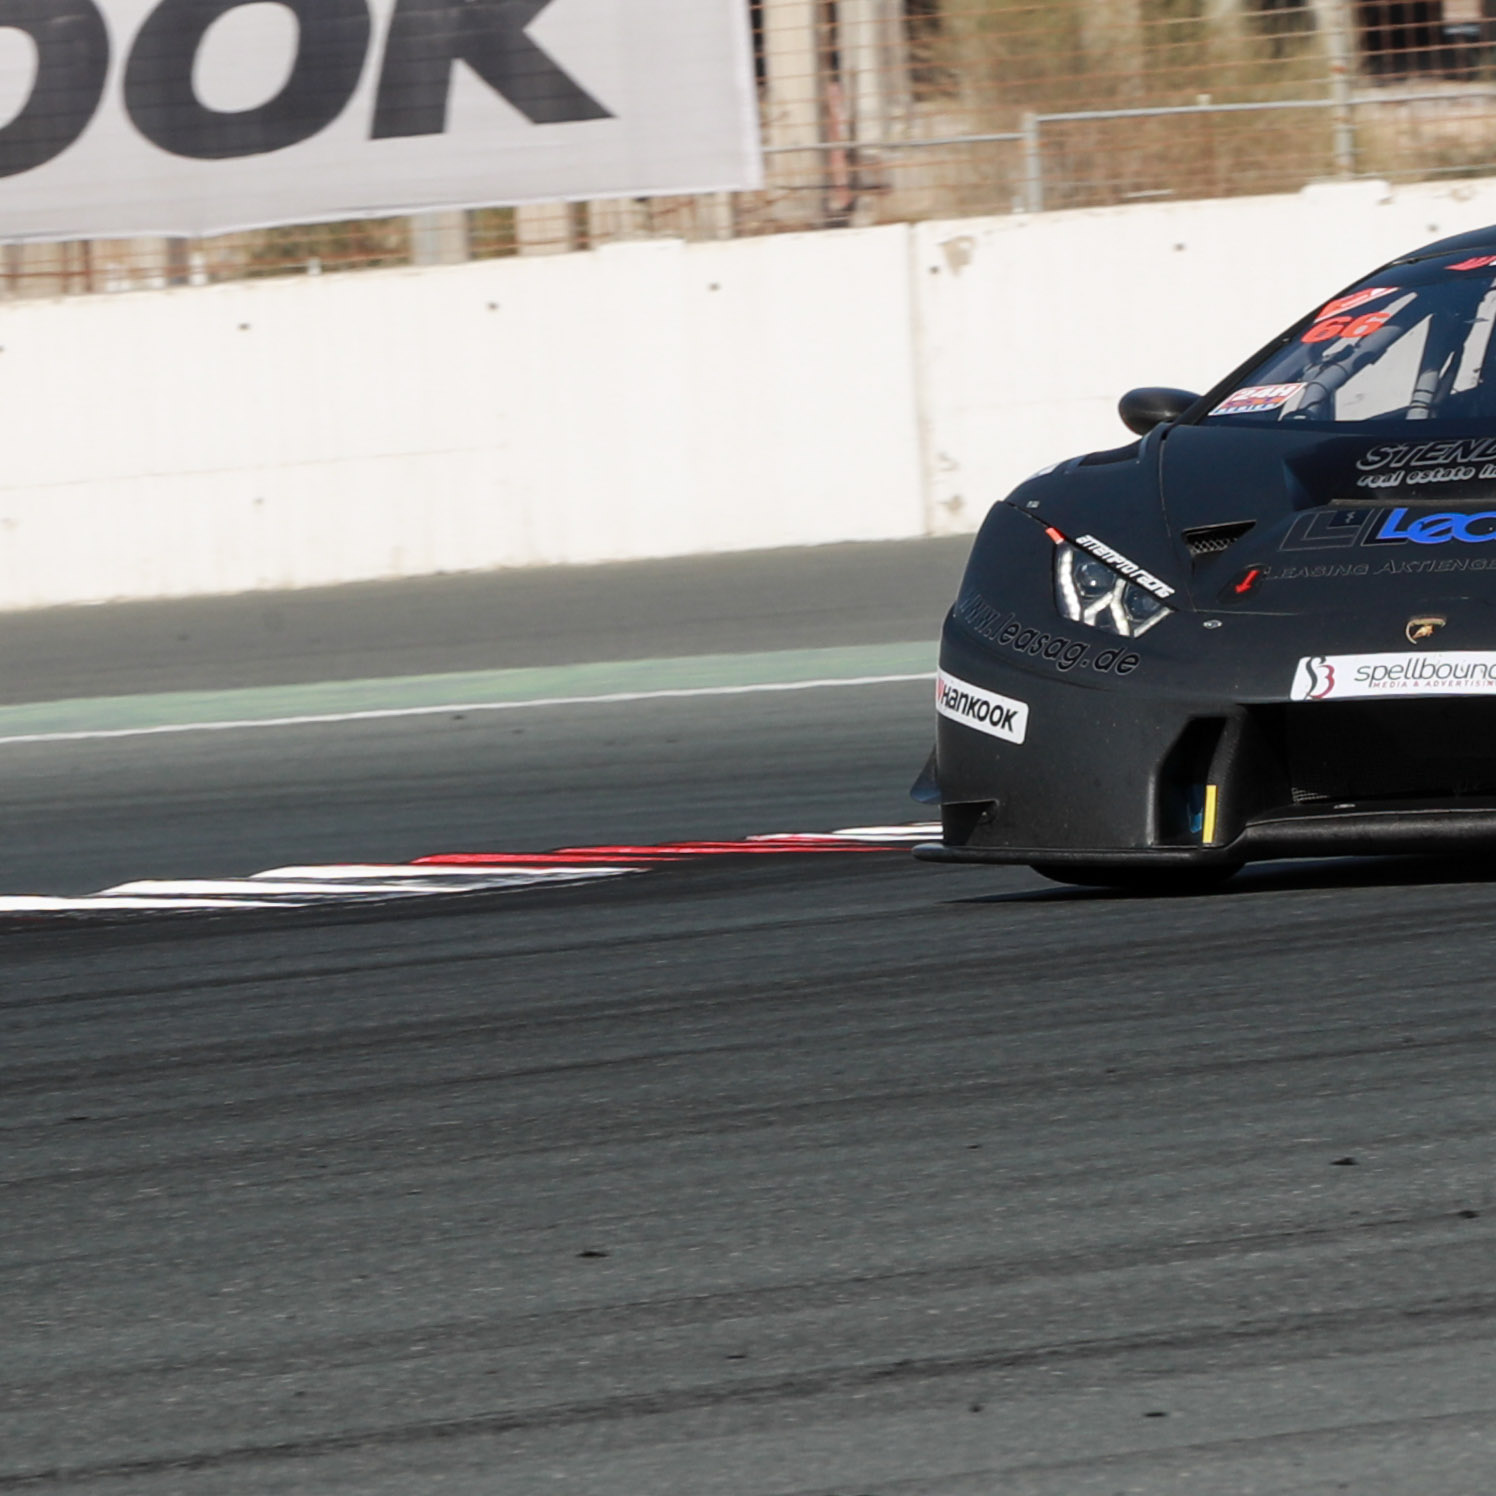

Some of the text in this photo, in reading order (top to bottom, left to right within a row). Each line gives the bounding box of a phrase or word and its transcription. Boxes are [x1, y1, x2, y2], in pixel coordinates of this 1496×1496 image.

[1301, 312, 1391, 343] 66
[1356, 467, 1401, 488] real
[1406, 466, 1475, 485] estate
[959, 594, 1141, 675] www.leasag.de
